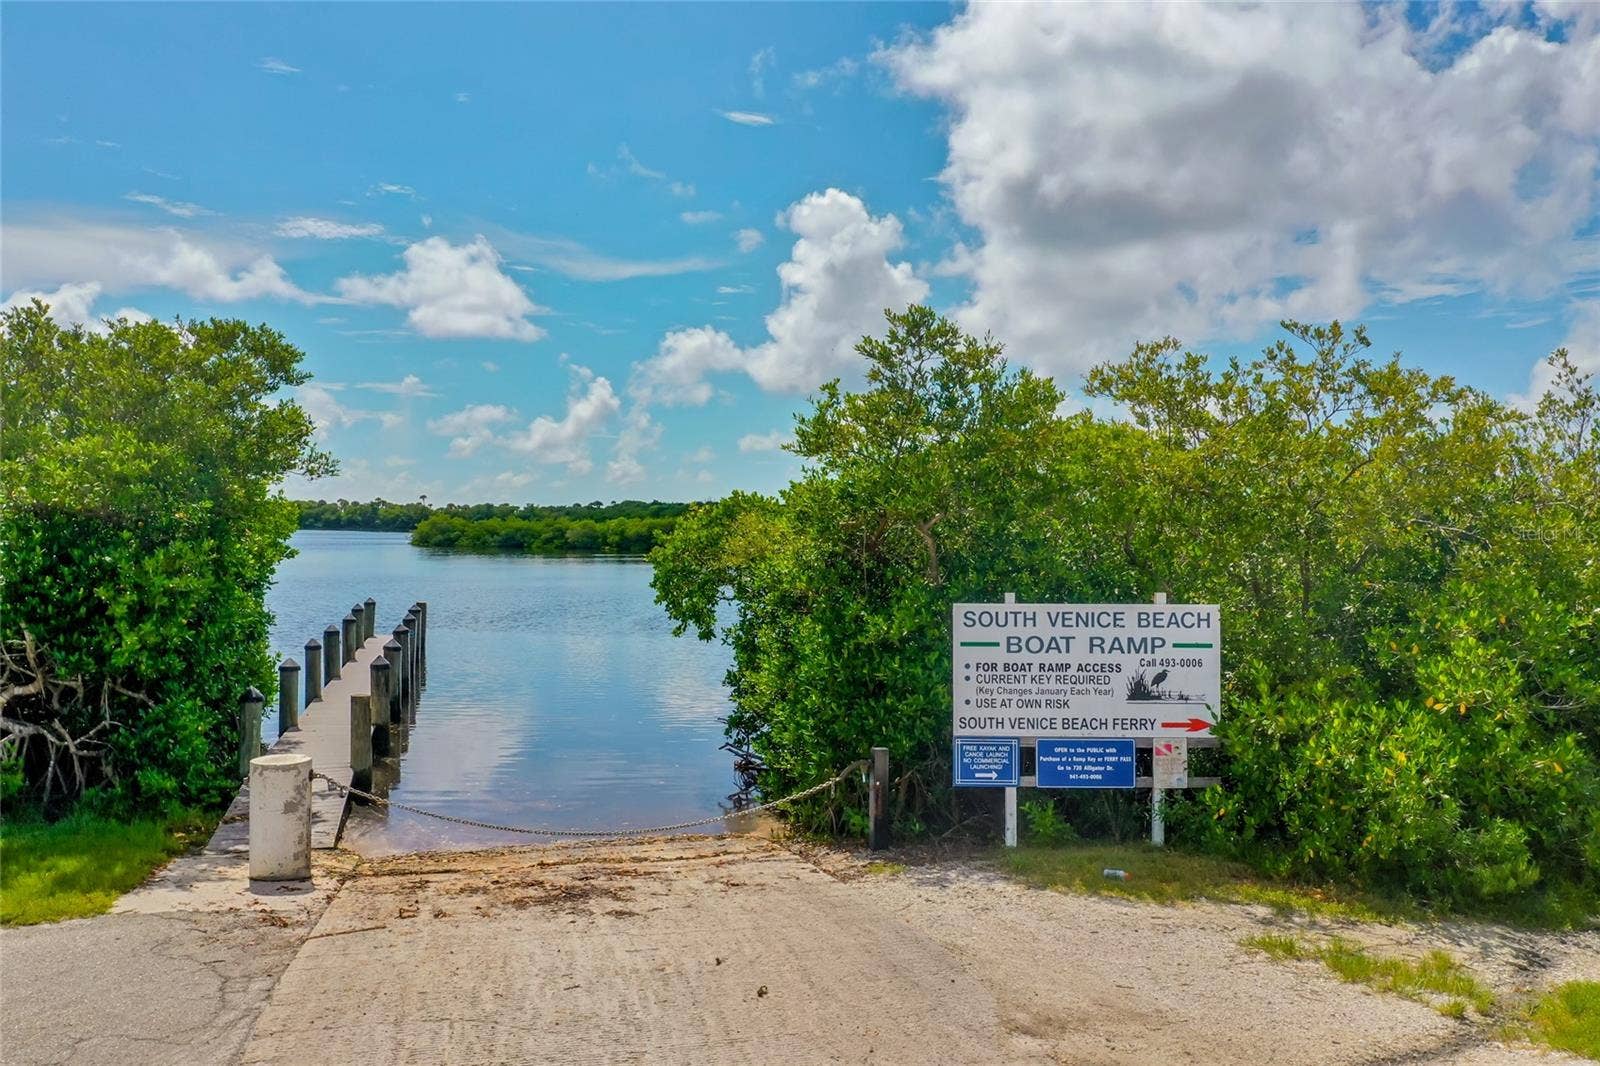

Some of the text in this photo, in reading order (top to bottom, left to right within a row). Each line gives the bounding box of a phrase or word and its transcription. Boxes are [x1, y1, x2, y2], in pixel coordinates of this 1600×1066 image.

[963, 611, 1210, 628] SOUTH VENICE BEACH
[1006, 636, 1166, 654] BOAT RAMP
[976, 663, 1122, 672] FOR BOAT RAMP ACCESS
[1140, 658, 1202, 668] Call 493-0006
[976, 675, 1110, 685] CURRENT KEY REQUIRED
[976, 687, 1114, 697] (Key Changes January Each Year)
[976, 699, 1070, 709] USE AT OWN RISK
[959, 717, 1157, 730] SOUTH VENICE BEACH FERRY
